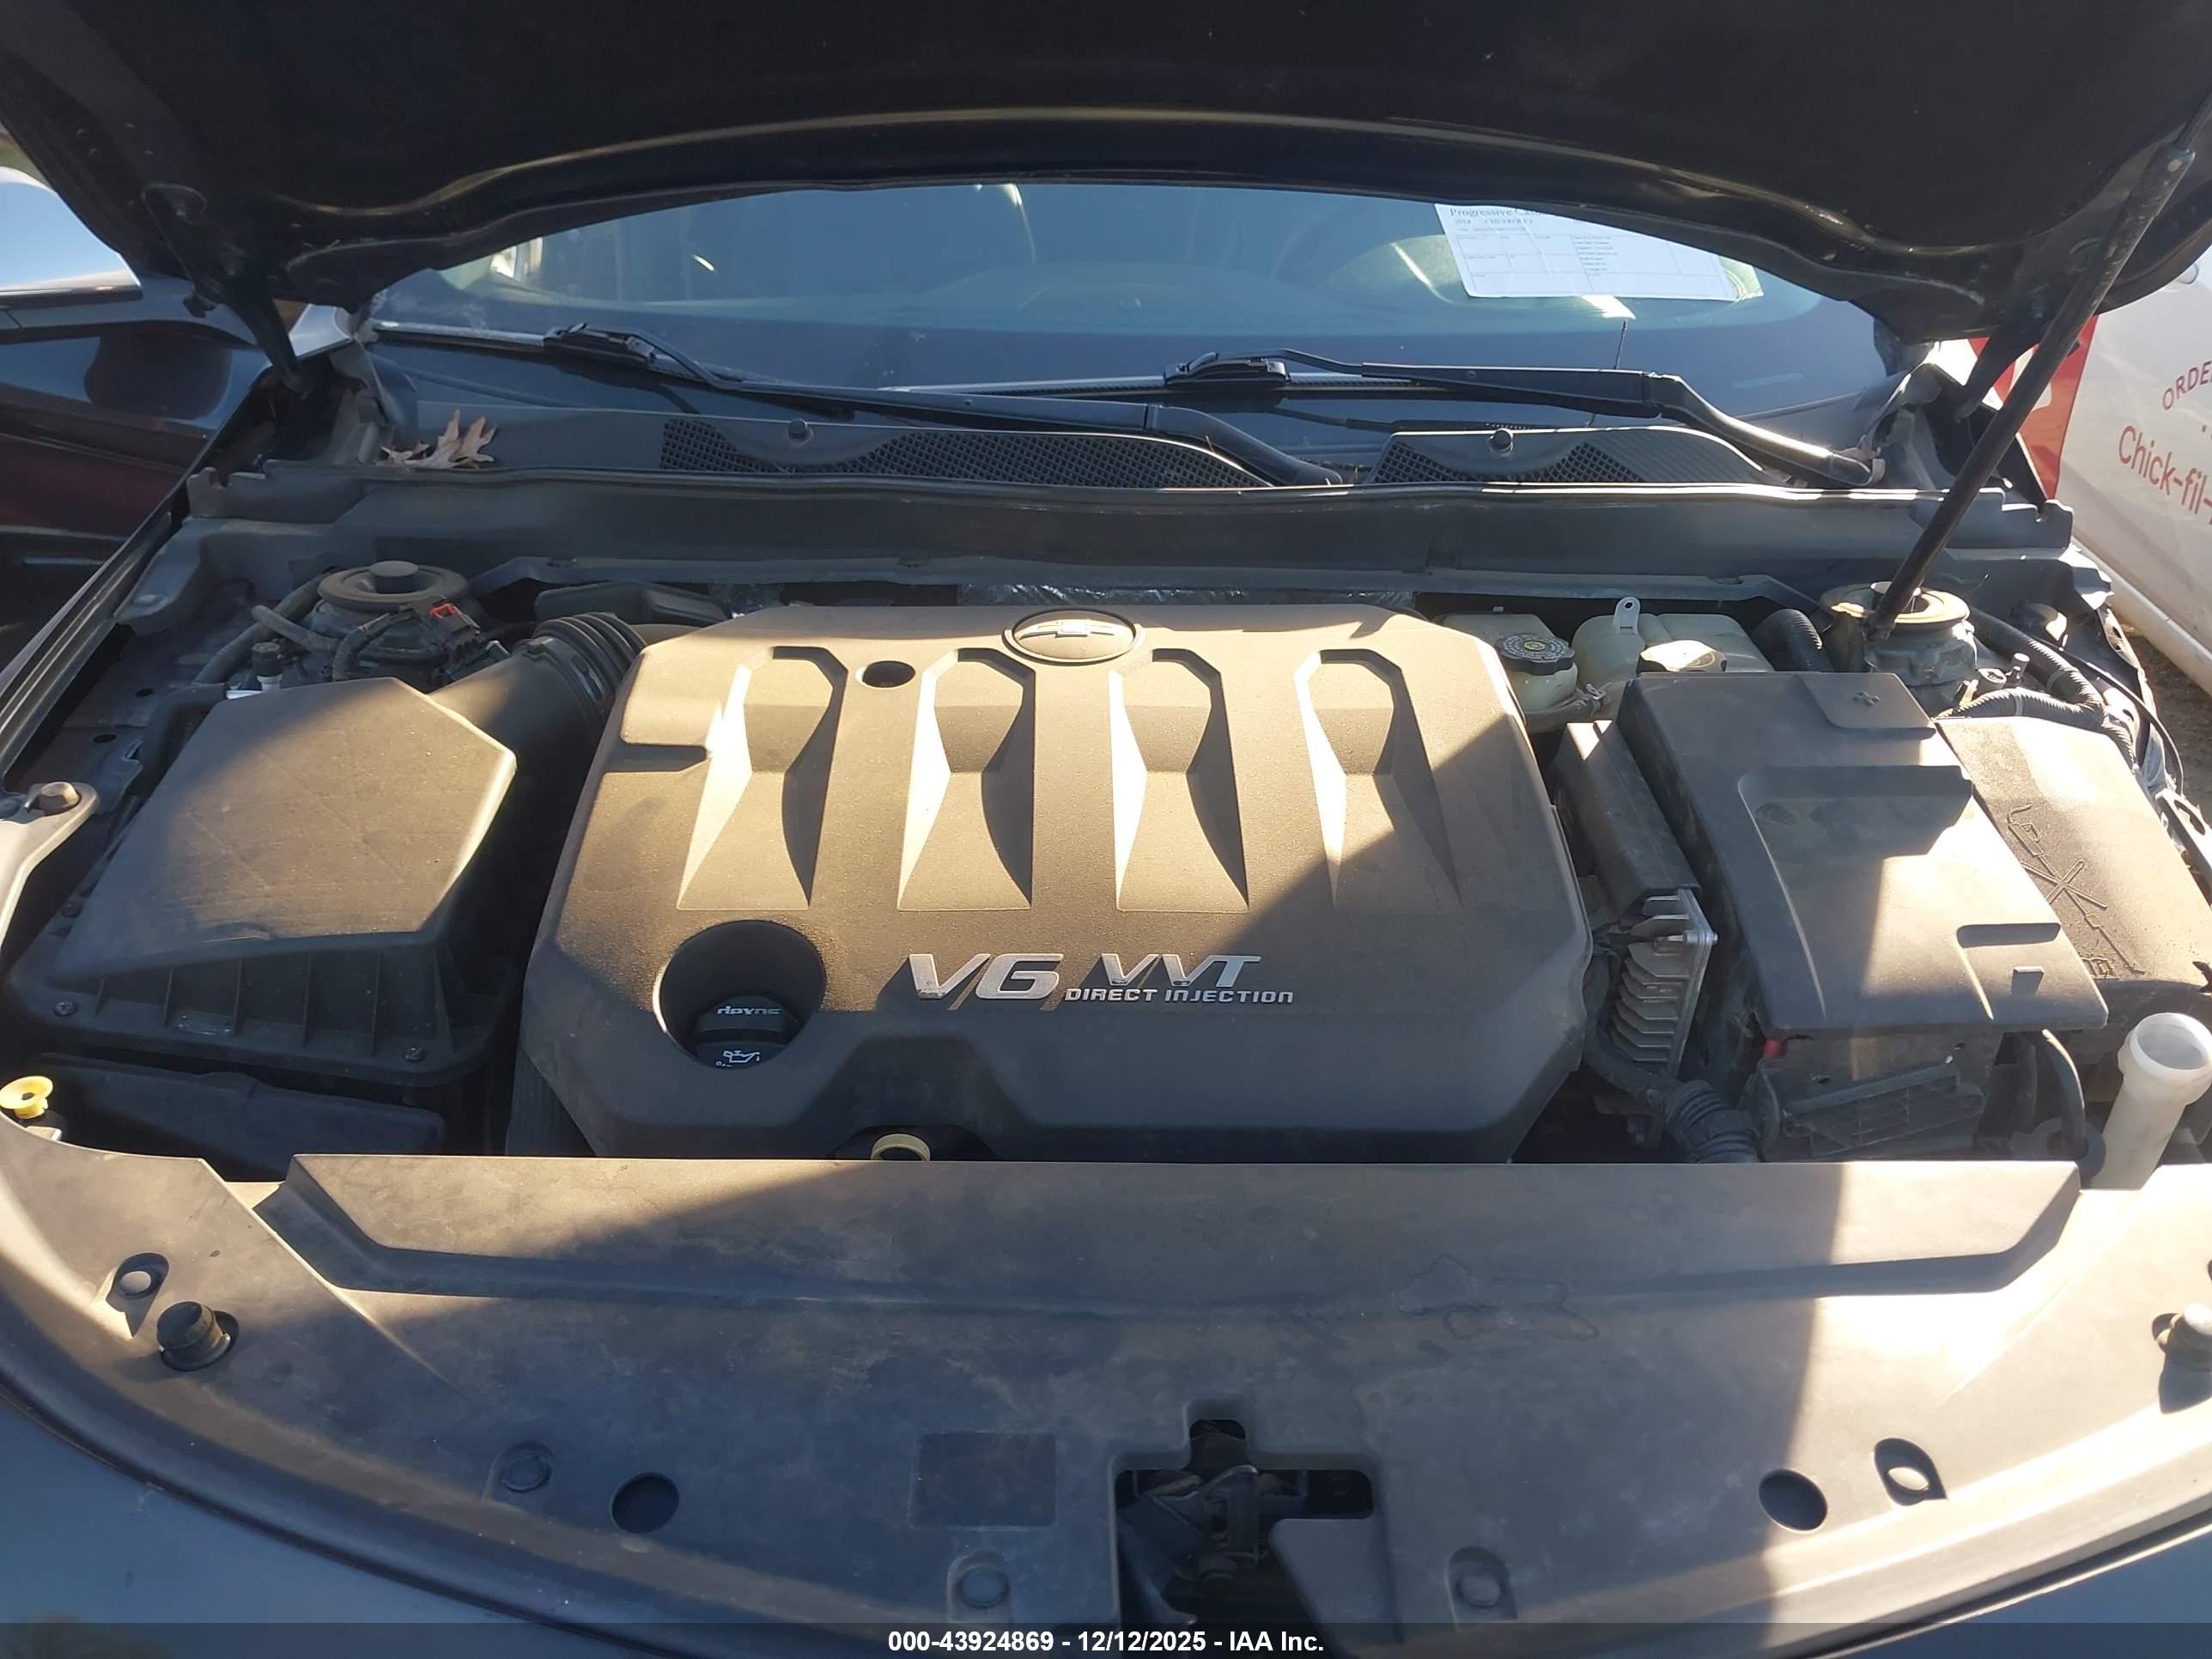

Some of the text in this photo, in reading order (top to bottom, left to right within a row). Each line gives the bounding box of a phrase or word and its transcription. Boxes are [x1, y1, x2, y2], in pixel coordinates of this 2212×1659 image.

[1449, 208, 1513, 218] Progressive
[2161, 360, 2212, 410] ORDE
[2118, 425, 2212, 525] Chick-fil-
[908, 953, 1262, 1000] V6 VVT
[1064, 988, 1294, 1004] DIRECT INJECTION
